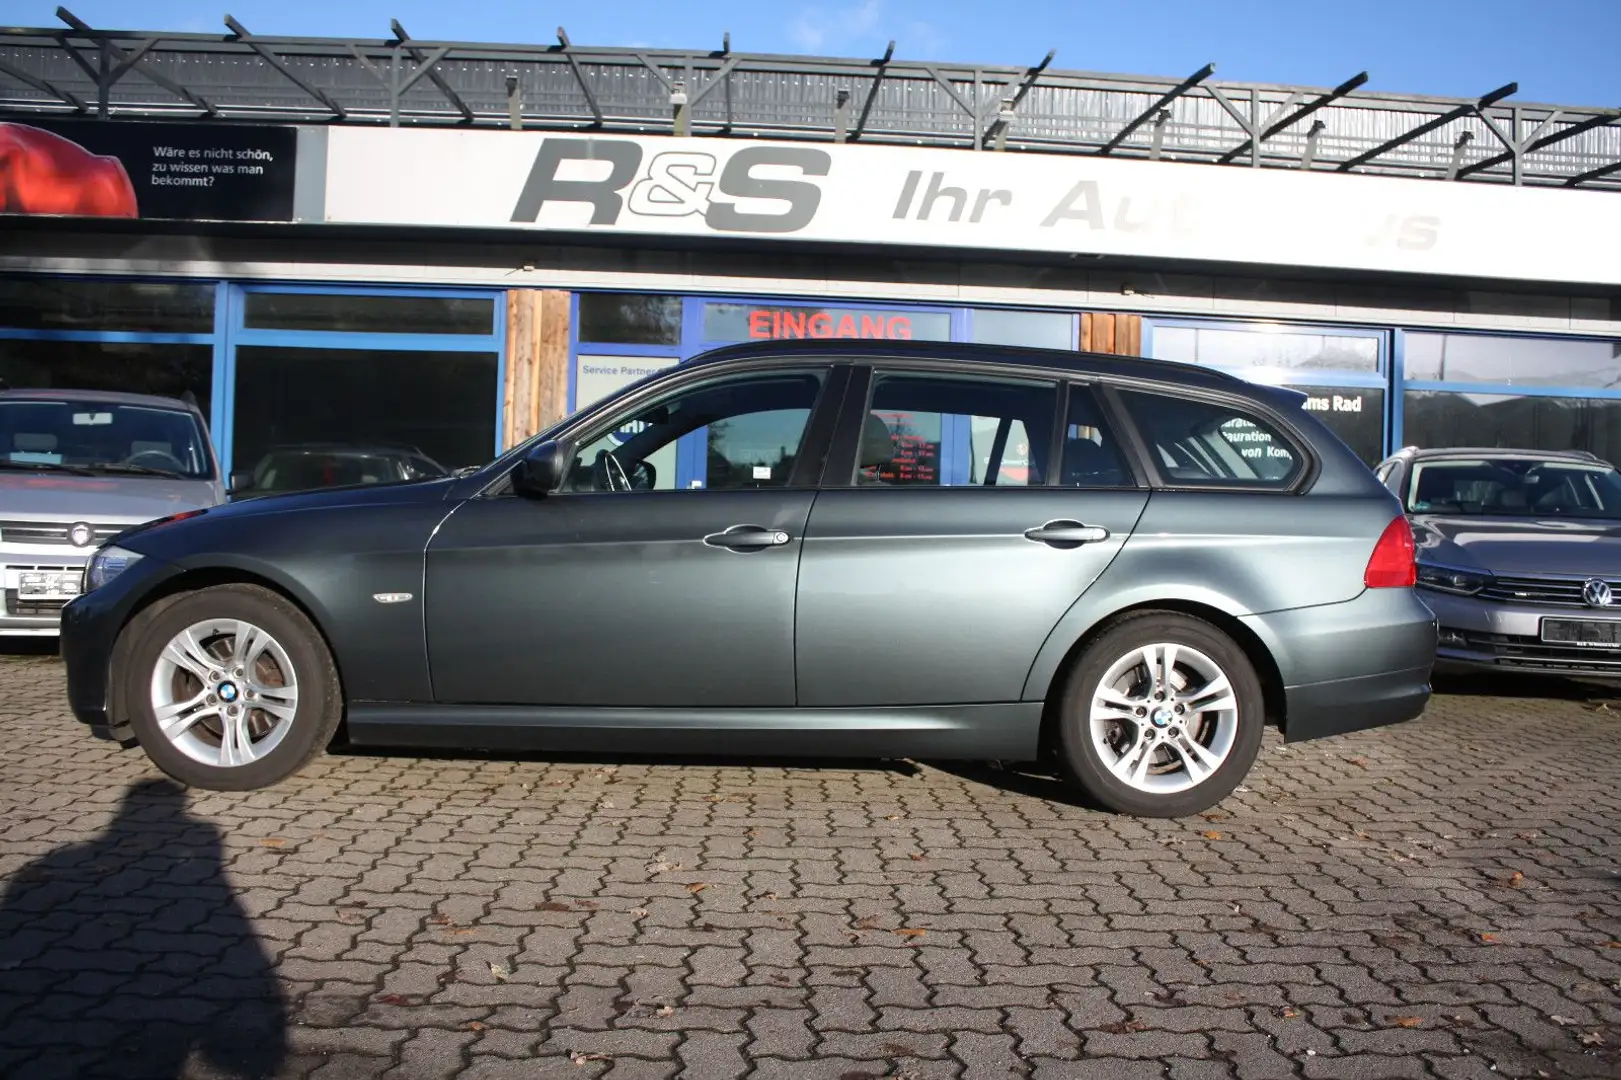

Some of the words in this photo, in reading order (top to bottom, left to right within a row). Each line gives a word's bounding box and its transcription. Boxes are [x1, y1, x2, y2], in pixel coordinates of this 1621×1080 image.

[152, 146, 186, 158] Wäre
[188, 149, 201, 158] es
[203, 148, 234, 159] nicht
[236, 149, 273, 162] schön,
[152, 163, 167, 172] zu
[169, 162, 209, 173] wissen
[211, 165, 235, 174] was
[237, 166, 264, 175] man
[151, 175, 215, 187] bekommt?
[509, 137, 833, 233] R&S
[892, 170, 1013, 224] Ihr
[749, 309, 912, 341] EINGANG
[582, 365, 618, 376] Service
[621, 366, 656, 377] Partner
[1333, 395, 1362, 412] Rad
[1241, 447, 1262, 458] von
[1266, 445, 1293, 460] Kom
